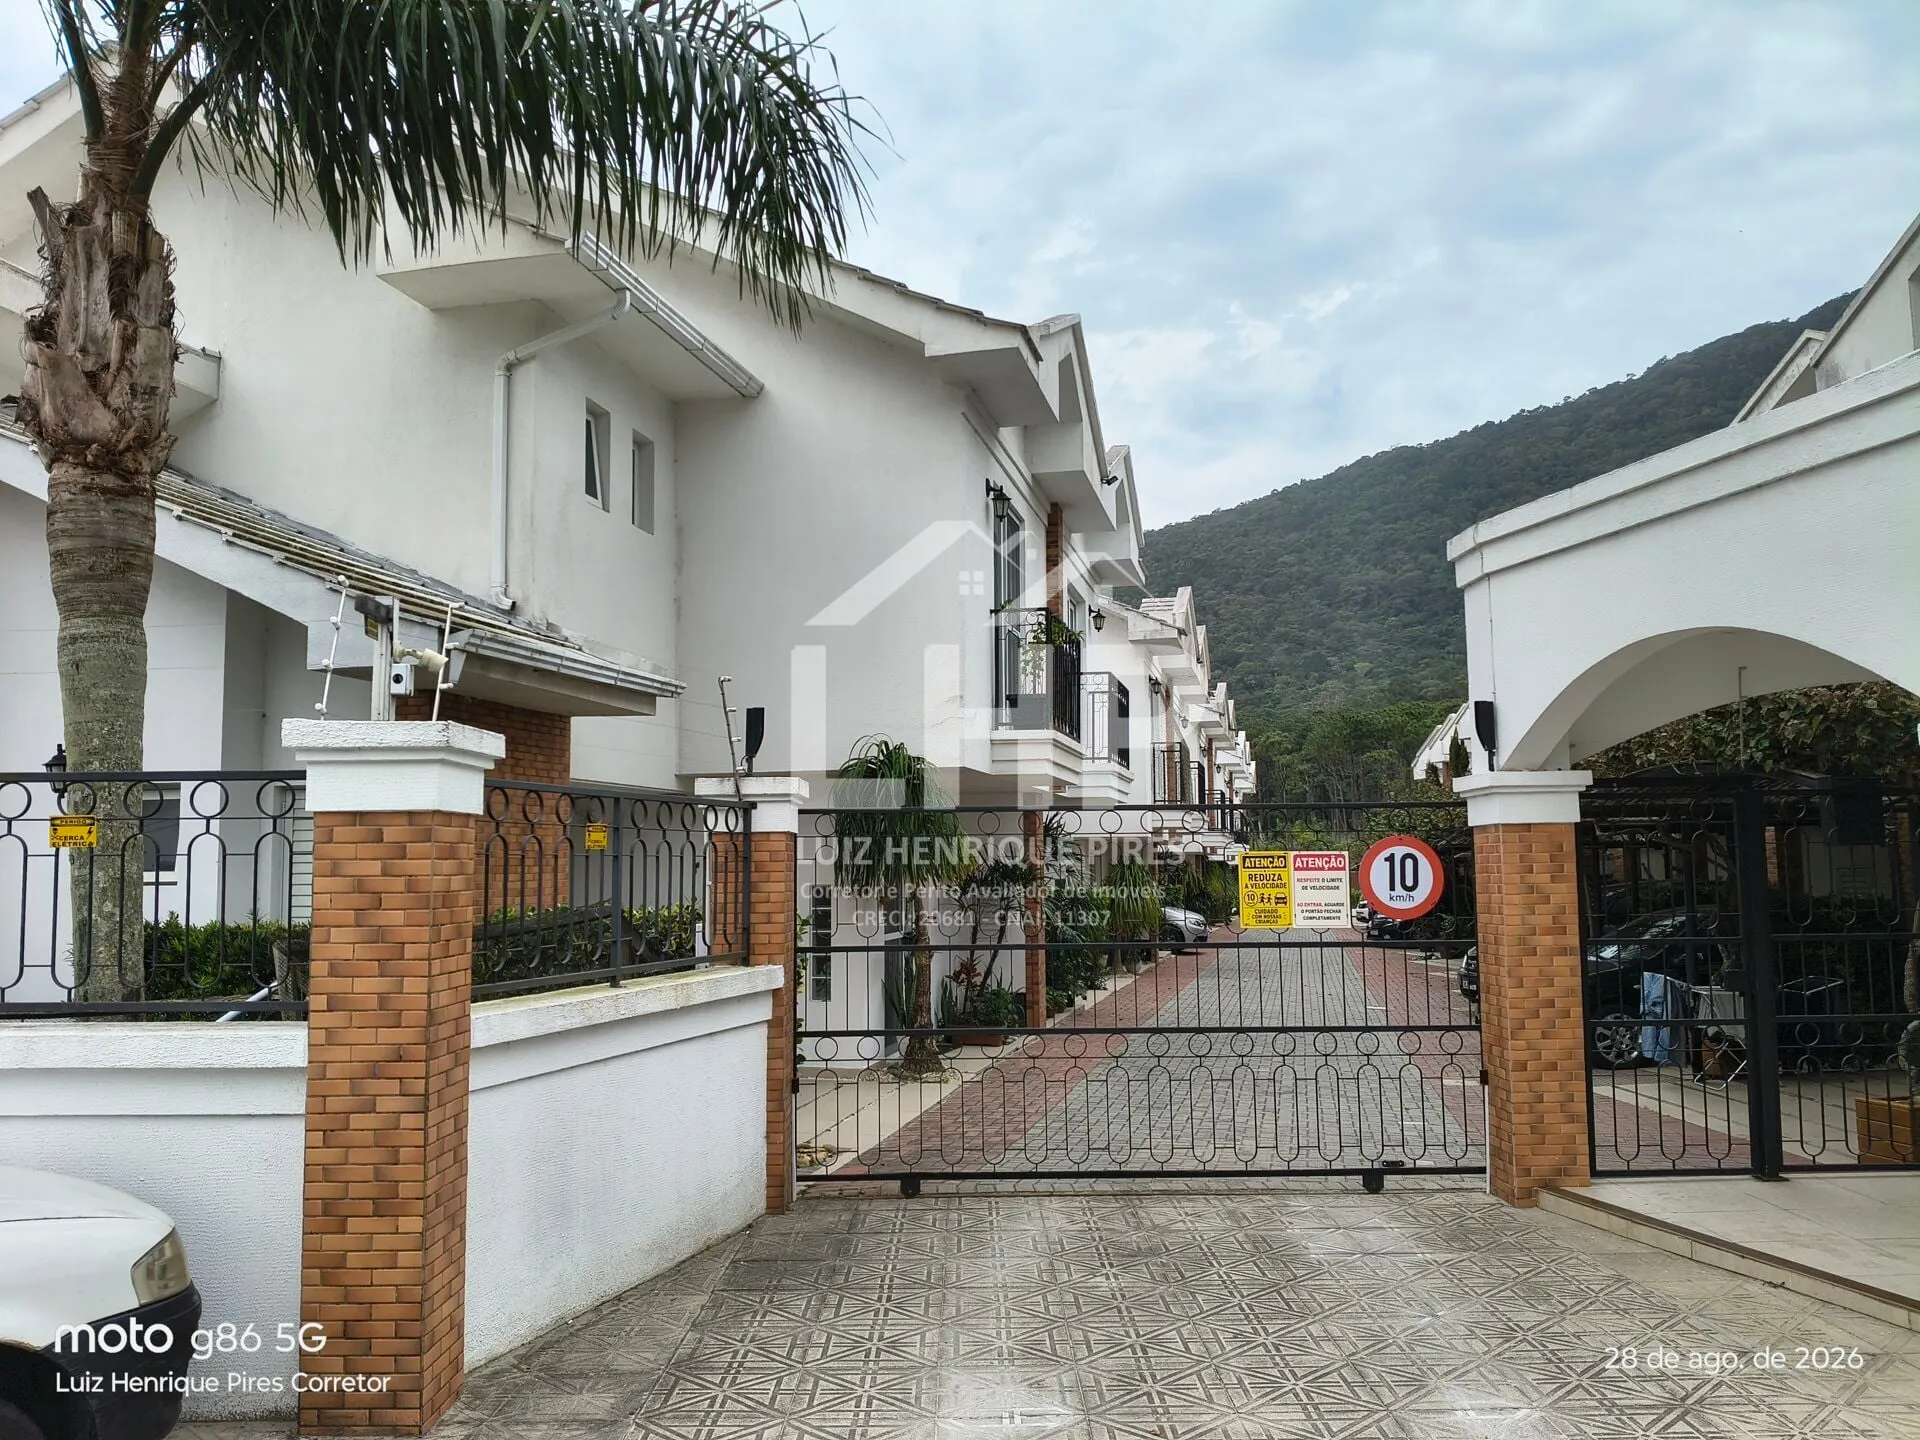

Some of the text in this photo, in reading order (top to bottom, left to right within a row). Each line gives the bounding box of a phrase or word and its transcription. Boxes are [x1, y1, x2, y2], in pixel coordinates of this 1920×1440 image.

[1244, 856, 1286, 869] ATENÇÃO
[1295, 855, 1345, 870] ATENÇÃO
[1248, 873, 1283, 882] REDUZA
[1384, 852, 1419, 892] 10
[1247, 893, 1256, 901] 10
[1389, 893, 1415, 902] km/h
